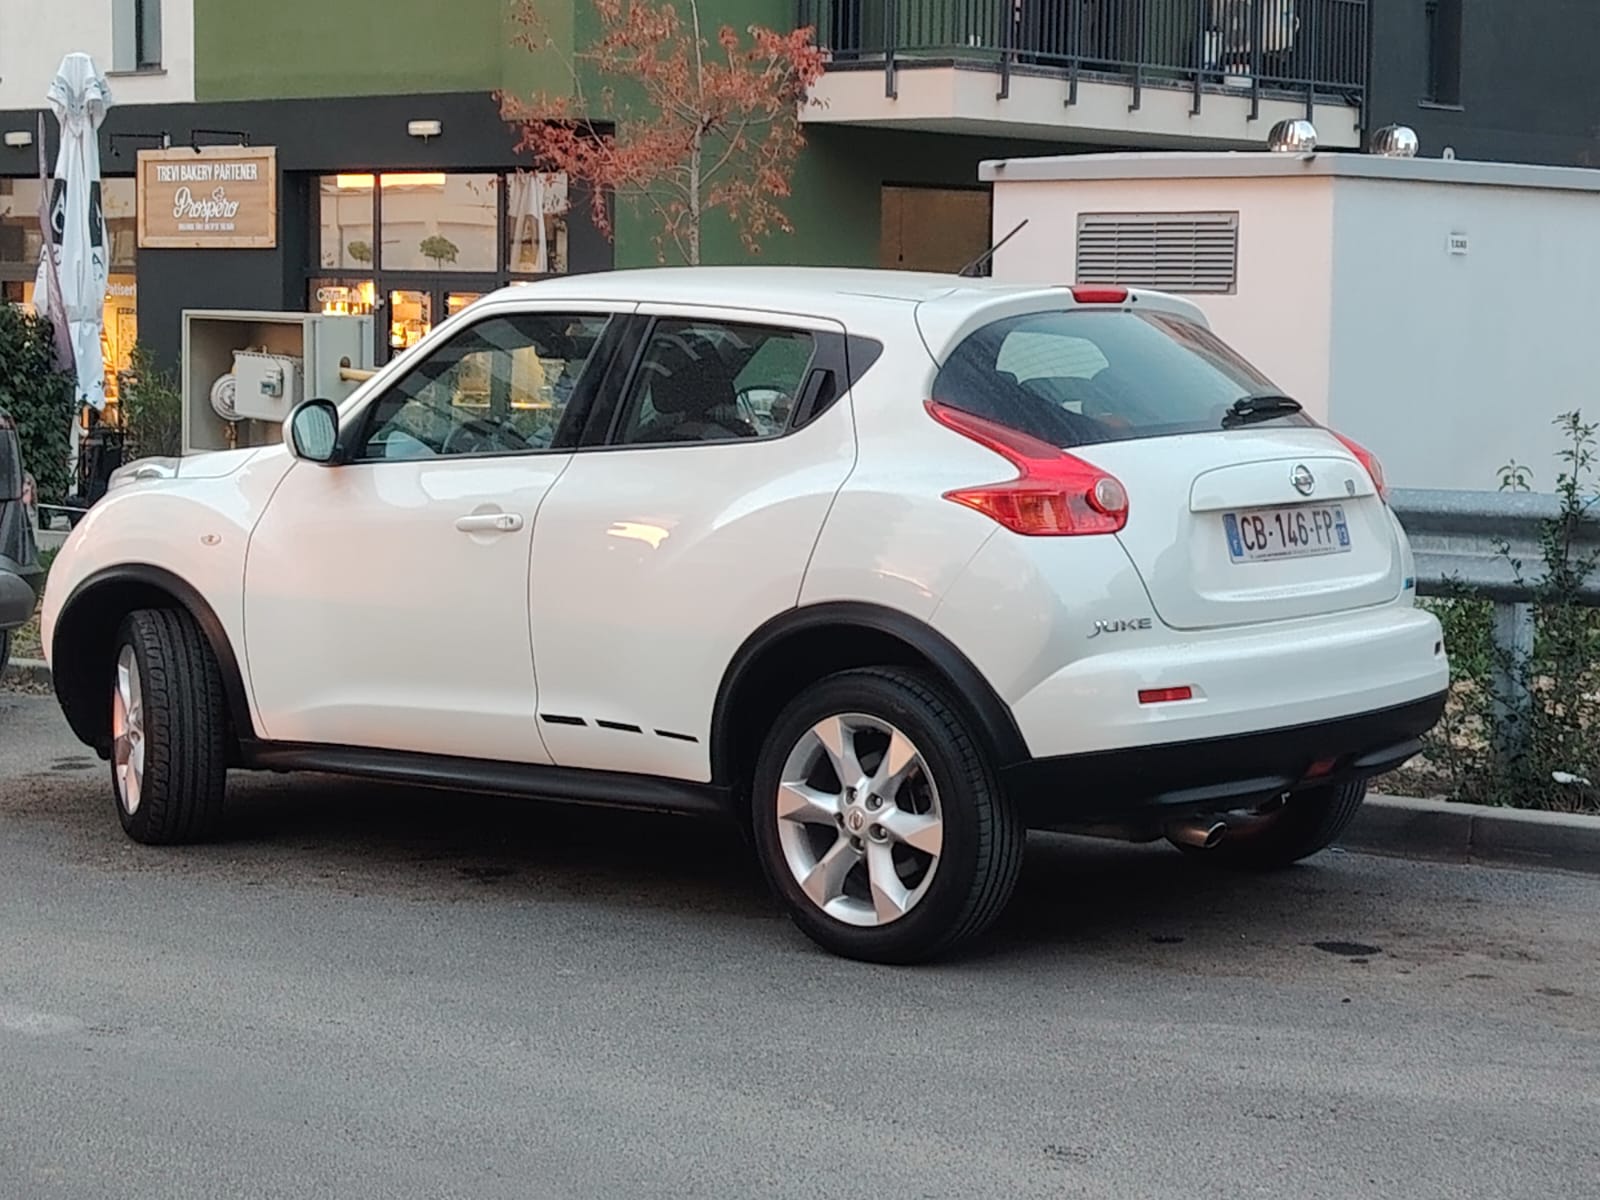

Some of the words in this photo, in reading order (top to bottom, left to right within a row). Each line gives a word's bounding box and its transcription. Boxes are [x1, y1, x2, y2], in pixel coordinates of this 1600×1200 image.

[157, 165, 180, 182] TREVI
[181, 164, 213, 181] BAKERY
[214, 163, 258, 180] PARTENER
[1086, 617, 1153, 639] JUKE
